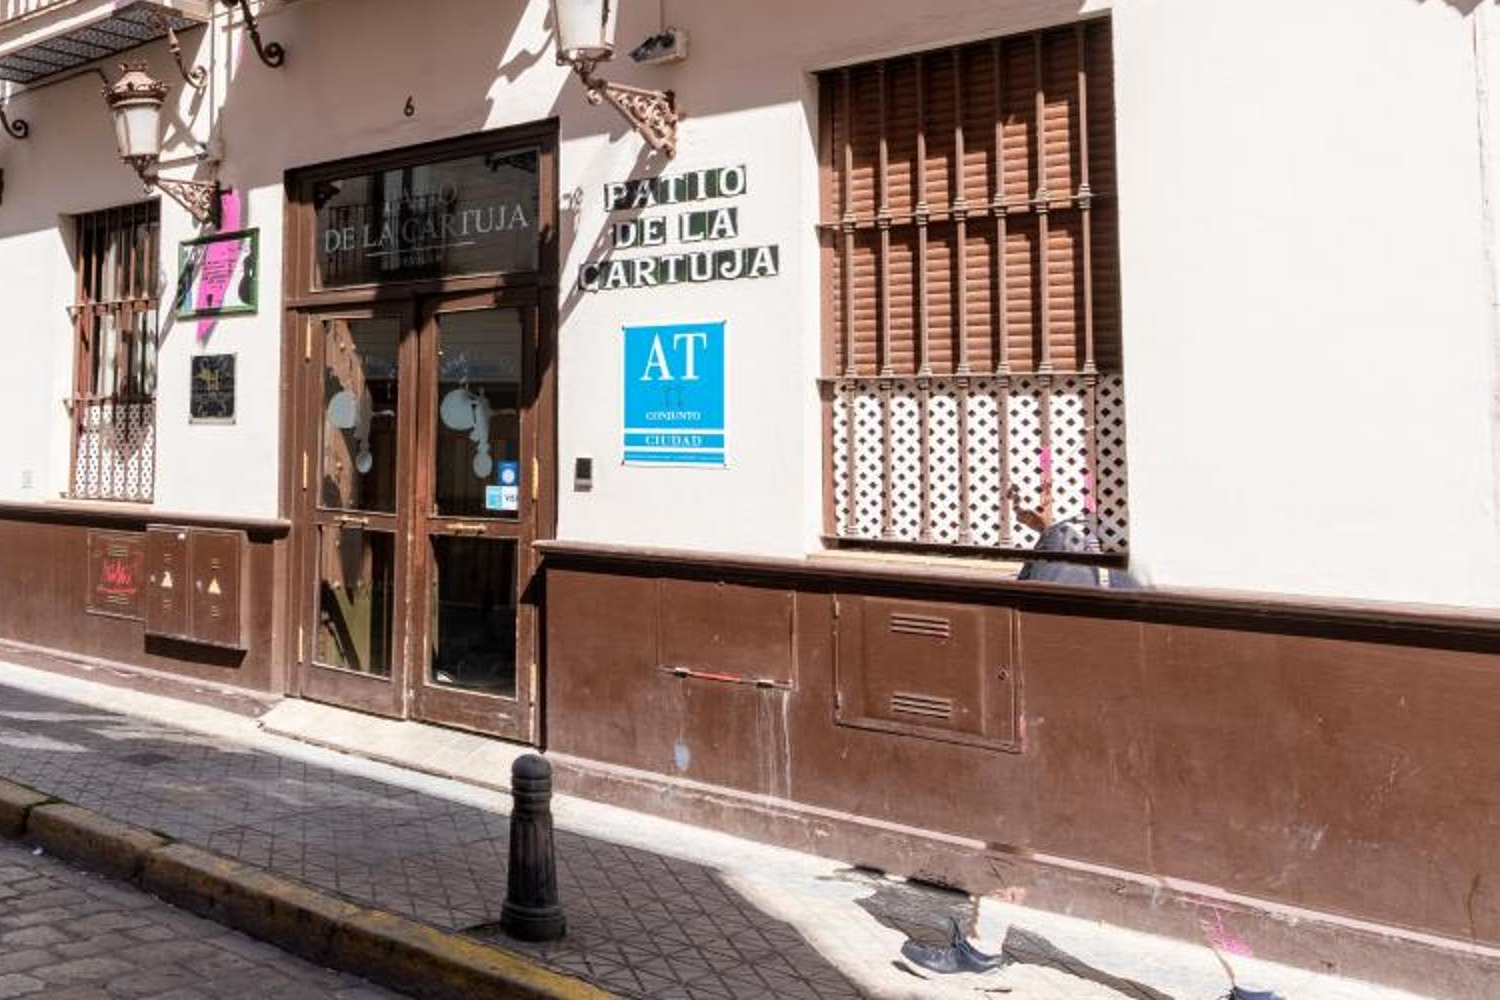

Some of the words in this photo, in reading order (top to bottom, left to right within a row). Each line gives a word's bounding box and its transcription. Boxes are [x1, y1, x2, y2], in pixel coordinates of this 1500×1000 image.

[403, 95, 415, 117] 6
[605, 165, 746, 211] PATIO
[325, 227, 355, 253] DE
[363, 220, 394, 249] LA
[402, 202, 529, 244] CARTUJA
[615, 216, 664, 248] DE
[680, 208, 736, 242] LA
[579, 246, 777, 292] CARTUJA
[639, 332, 707, 381] AT
[644, 435, 703, 447] CIUDAD
